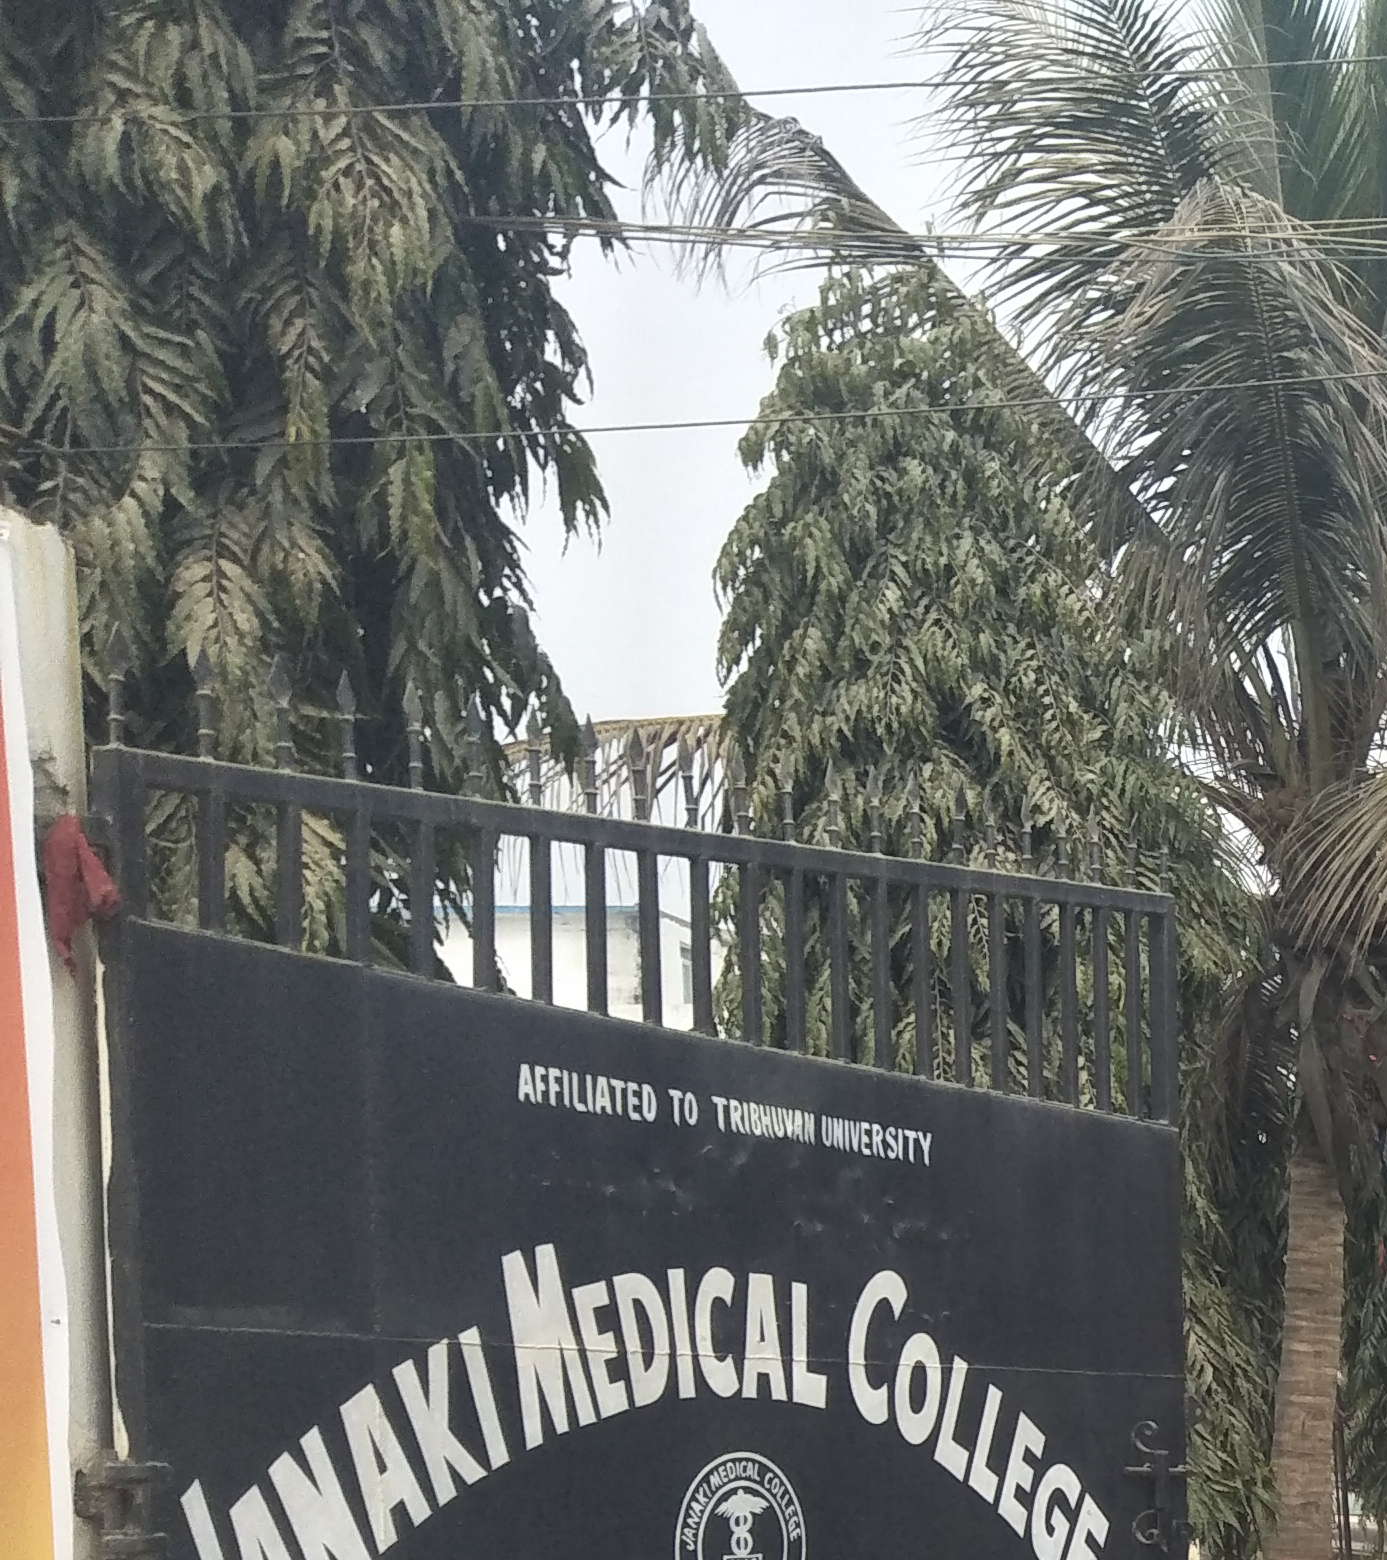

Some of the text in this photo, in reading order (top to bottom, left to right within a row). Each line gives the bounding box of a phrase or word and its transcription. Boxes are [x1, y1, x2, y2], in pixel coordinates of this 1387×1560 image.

[518, 1063, 933, 1167] AFFILIATED TO TRIBHUVAN UNIVERSITY
[501, 1243, 828, 1451] MEDICAL
[680, 1460, 802, 1551] JANAKI MEDICAL COLLEGE
